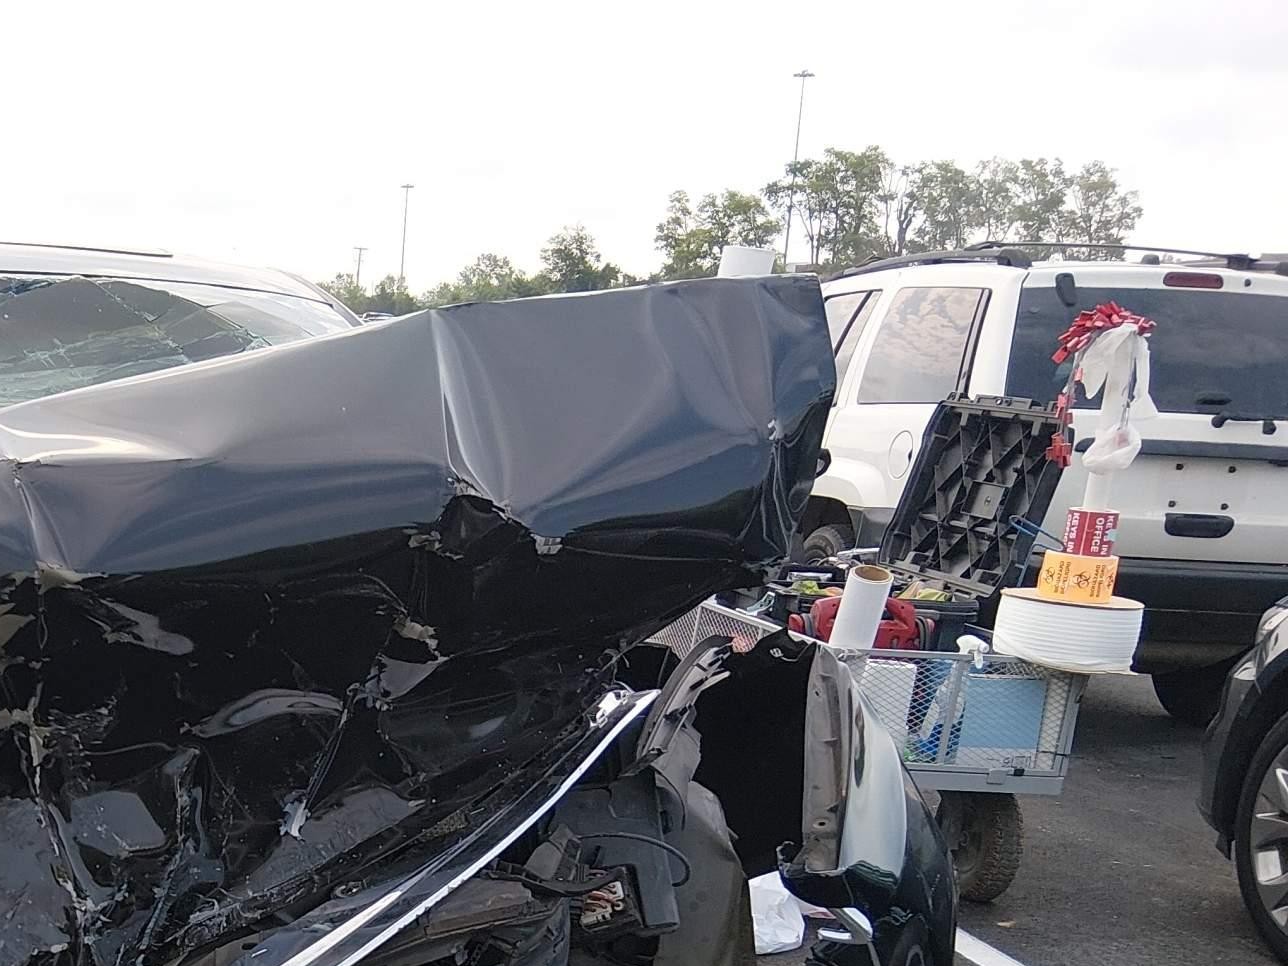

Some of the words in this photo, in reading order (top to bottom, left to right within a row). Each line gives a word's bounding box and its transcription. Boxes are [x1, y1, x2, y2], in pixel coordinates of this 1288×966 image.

[1069, 512, 1080, 539] KEYS
[1091, 518, 1104, 553] OFFICE
[1066, 541, 1074, 553] IN
[1100, 545, 1108, 555] IN
